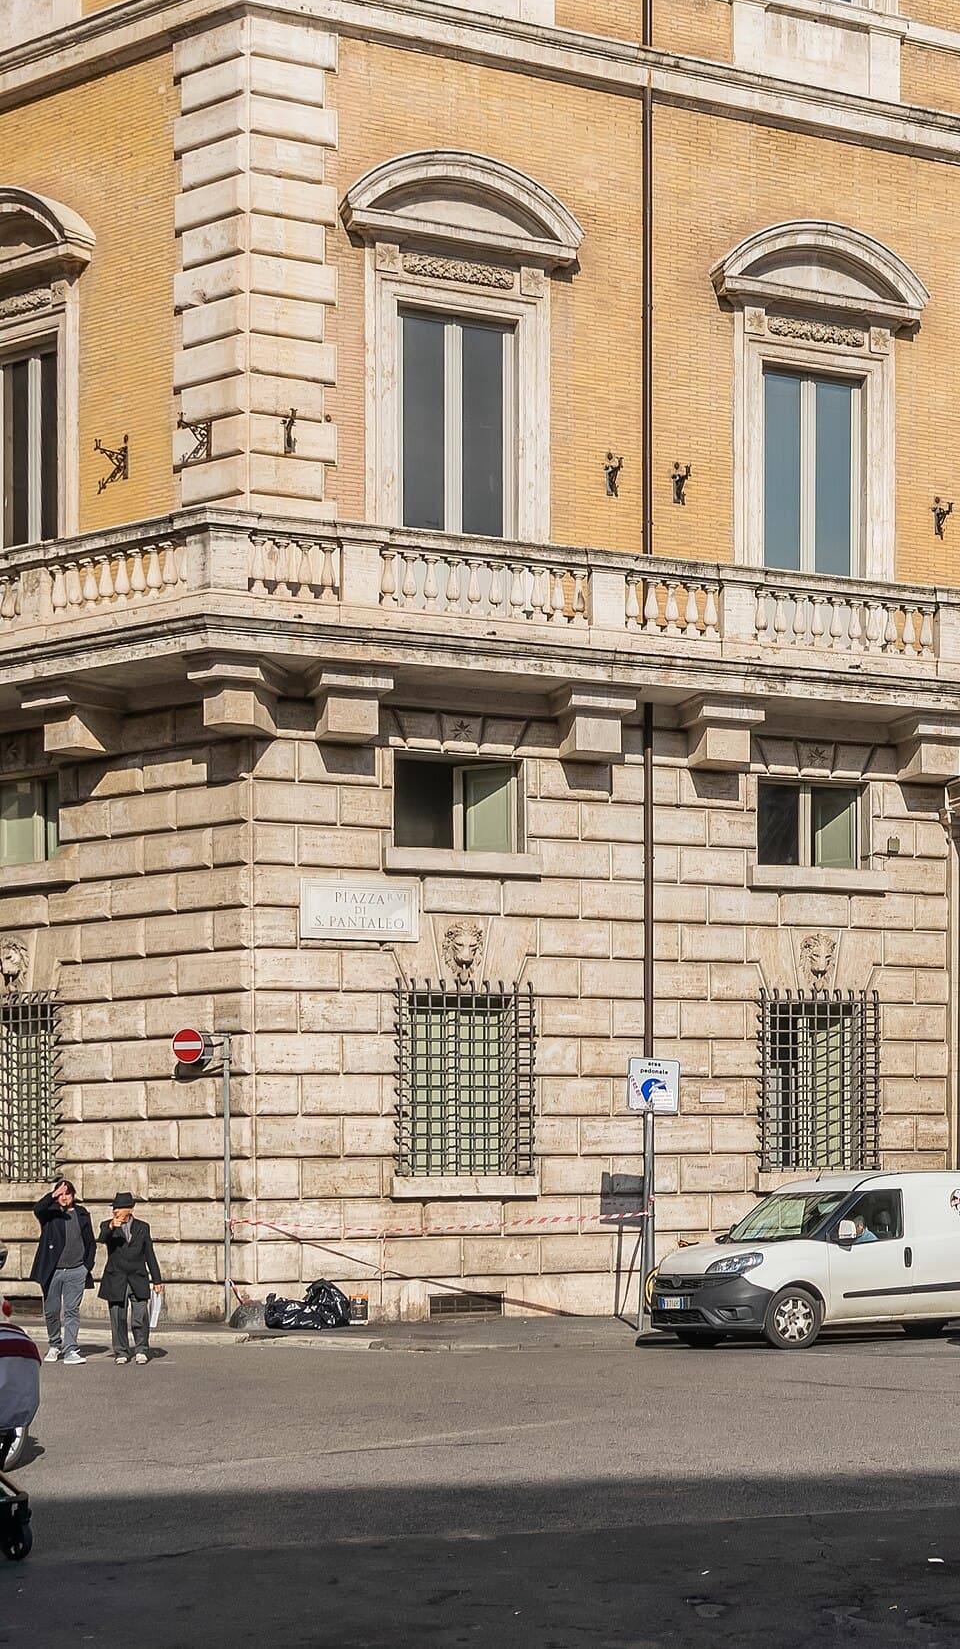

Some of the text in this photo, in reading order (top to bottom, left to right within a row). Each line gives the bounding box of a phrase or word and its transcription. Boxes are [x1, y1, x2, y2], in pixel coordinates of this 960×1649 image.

[335, 891, 385, 905] PIAZZA
[354, 906, 366, 915] DI
[314, 915, 405, 929] S. PANTALEO
